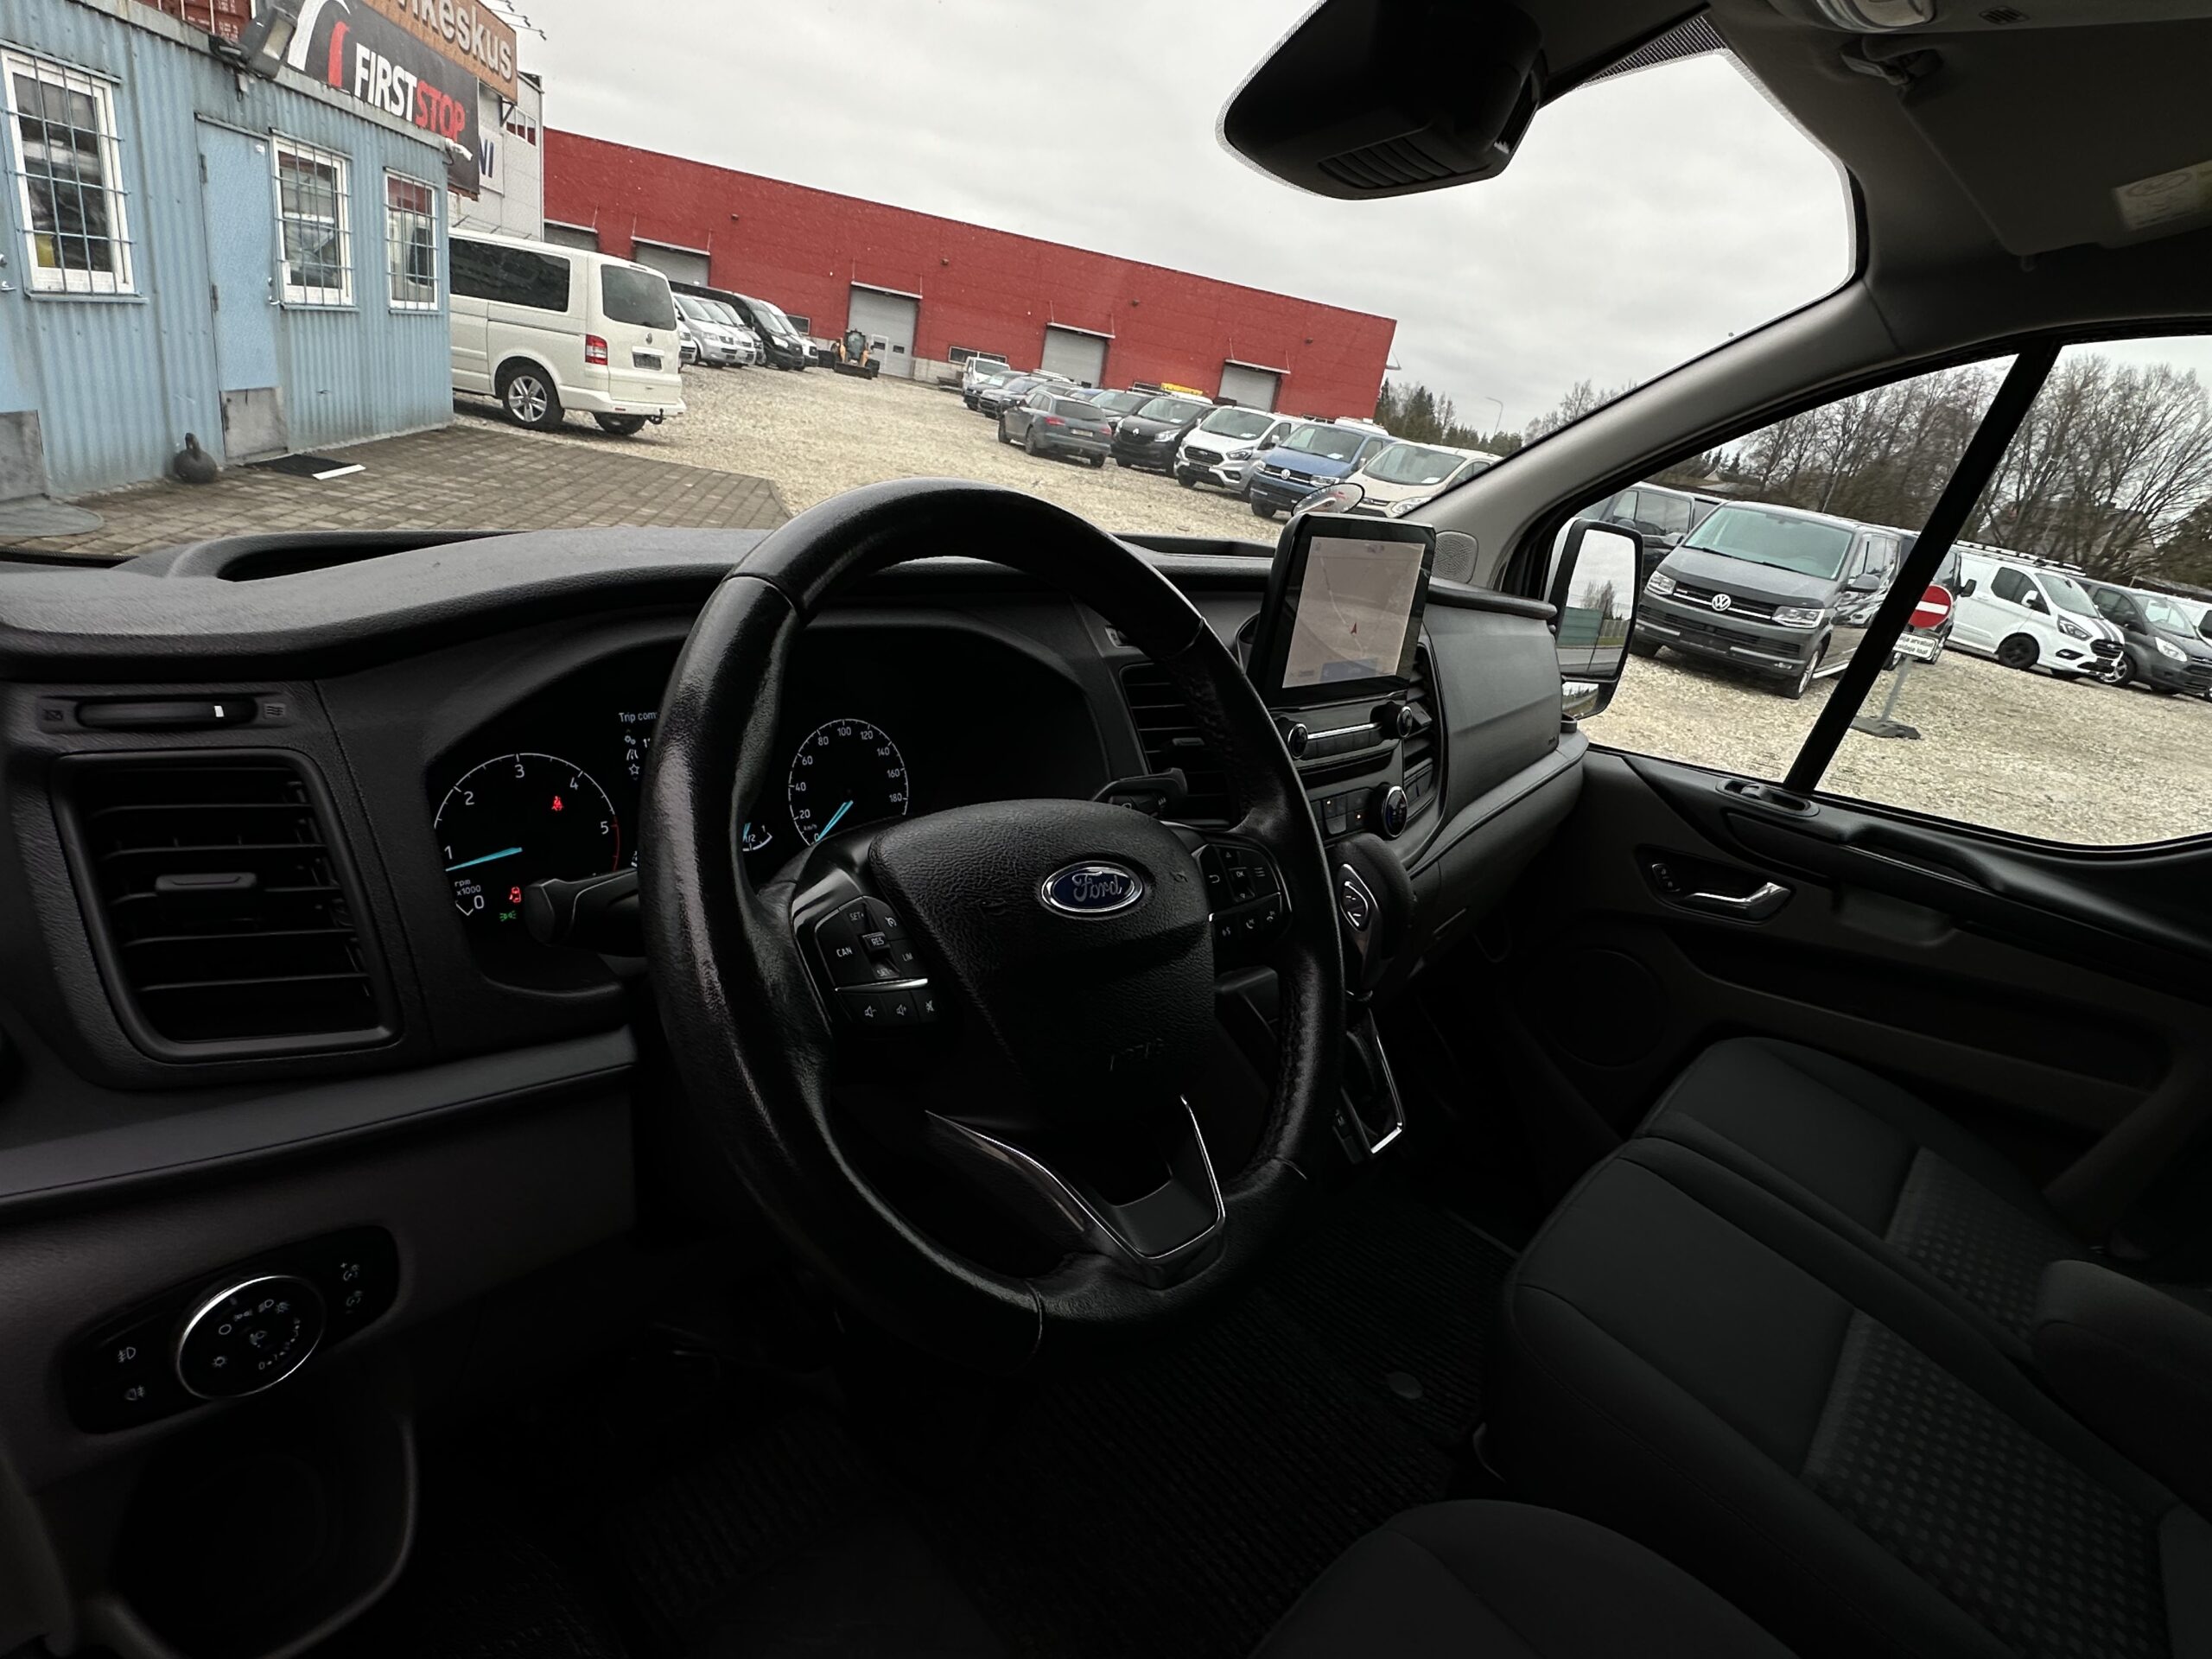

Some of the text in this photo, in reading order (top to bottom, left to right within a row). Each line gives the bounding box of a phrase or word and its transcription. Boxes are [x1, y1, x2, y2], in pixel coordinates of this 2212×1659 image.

[618, 712, 636, 724] Trip
[836, 727, 852, 736] 100
[860, 729, 874, 741] 120
[817, 735, 830, 746] 80
[876, 747, 890, 757] 140
[802, 755, 813, 766] 60
[514, 764, 525, 779] 3
[887, 768, 900, 779] 160
[569, 777, 579, 791] 4
[795, 781, 807, 792] 40
[464, 791, 474, 805] 2
[888, 792, 903, 803] 180
[798, 809, 810, 819] 20
[601, 821, 609, 835] 5
[444, 845, 453, 860] 1
[456, 885, 481, 896] x1000
[1071, 871, 1122, 902] Ford
[474, 894, 485, 909] 0
[870, 937, 885, 946] RES
[836, 947, 853, 957] CAN
